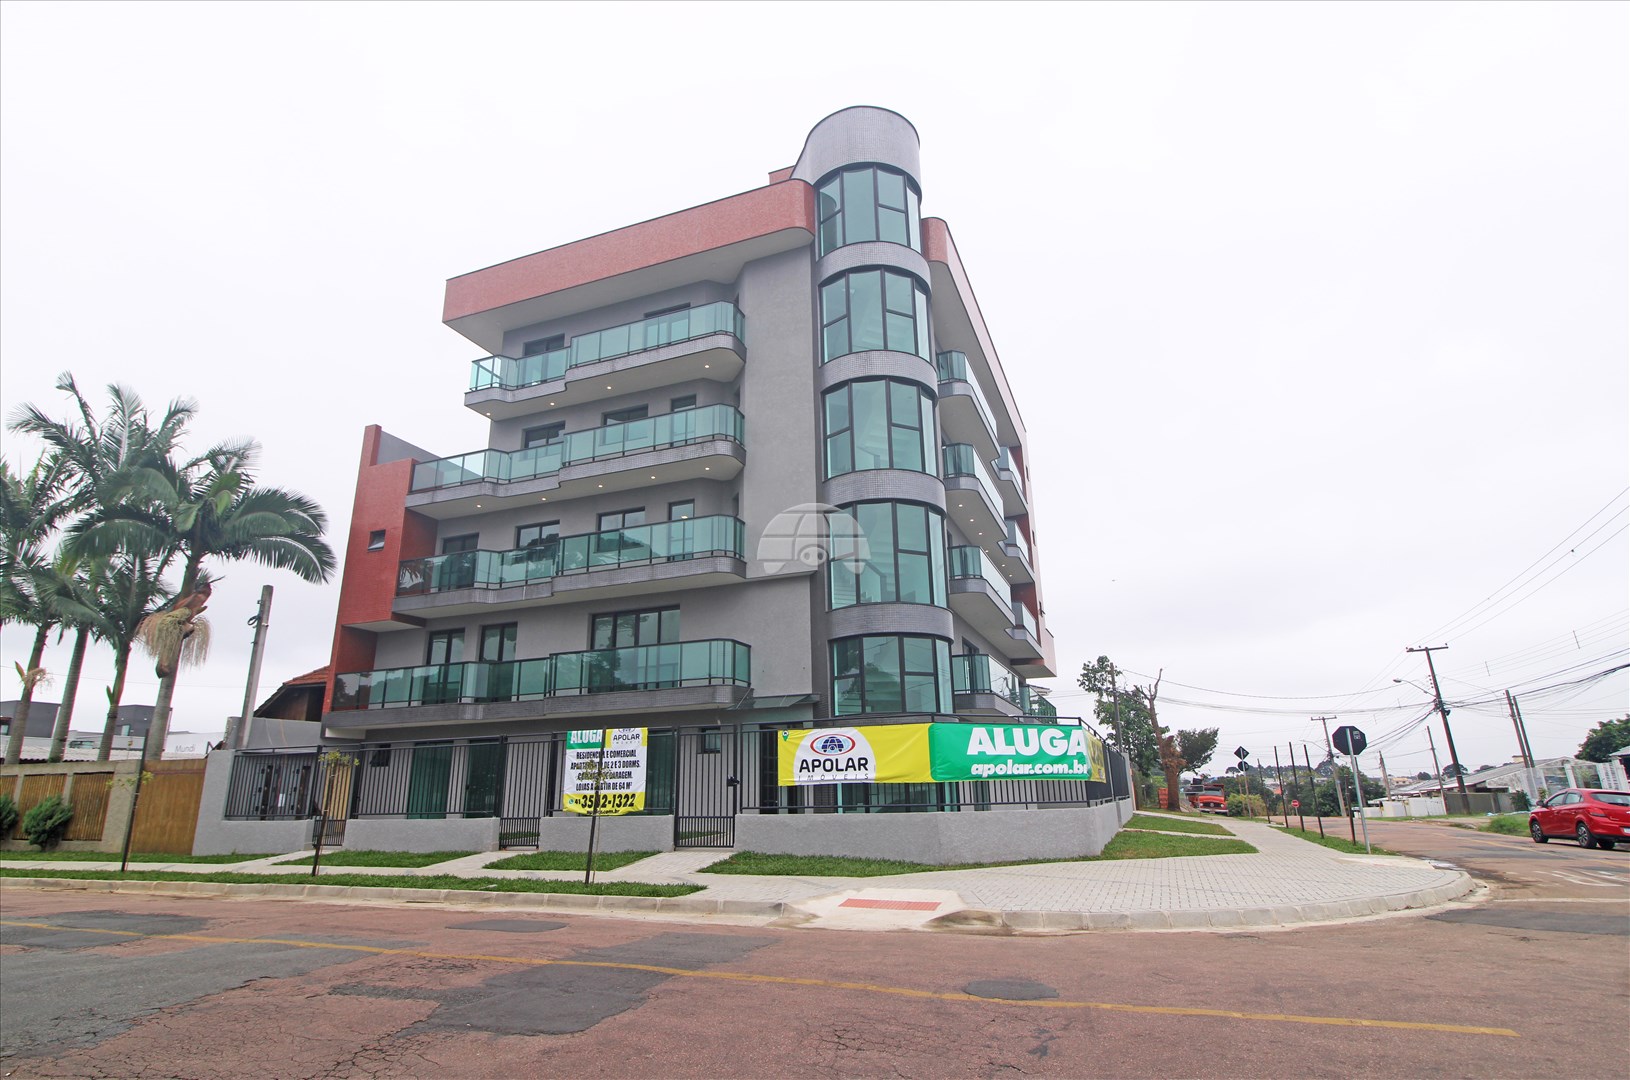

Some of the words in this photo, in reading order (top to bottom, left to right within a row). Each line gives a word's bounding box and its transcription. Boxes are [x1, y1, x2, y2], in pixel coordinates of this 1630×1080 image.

[613, 733, 641, 741] APOLAR
[966, 727, 1088, 756] ALUGA
[576, 750, 606, 759] RESIDENCIL
[609, 749, 637, 758] COMERCIAL
[798, 757, 869, 773] APOLAR
[581, 793, 636, 808] 352-1322
